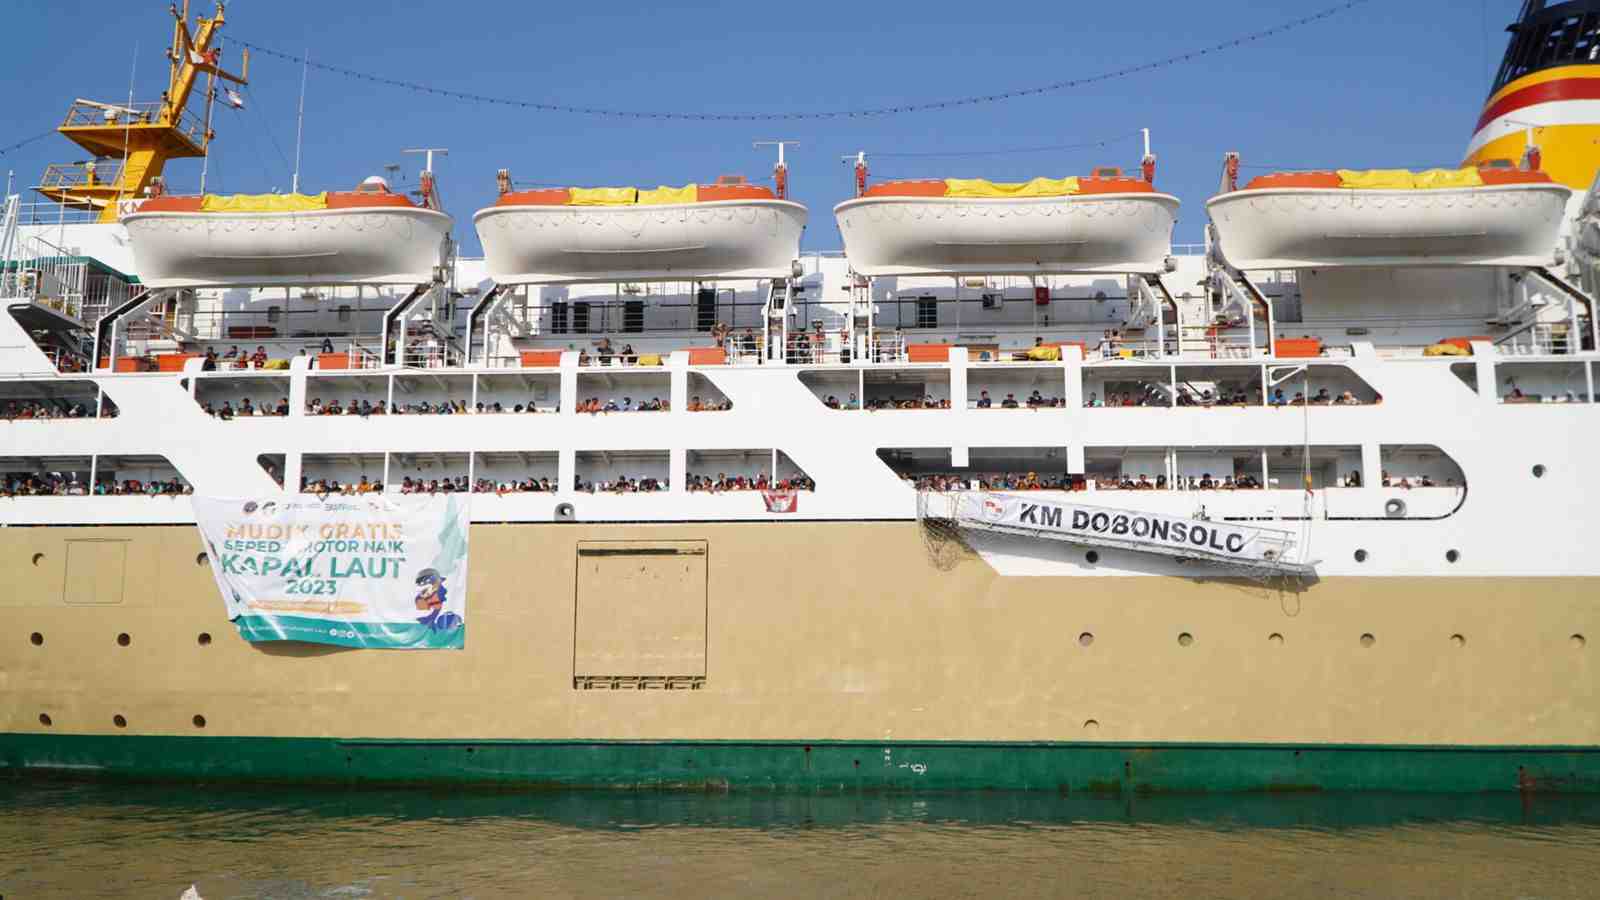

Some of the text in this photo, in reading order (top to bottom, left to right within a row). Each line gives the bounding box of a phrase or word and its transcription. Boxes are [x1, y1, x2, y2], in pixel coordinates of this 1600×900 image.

[1019, 503, 1063, 528] KM
[320, 523, 403, 539] GRATIS
[224, 540, 286, 552] SEPED
[363, 540, 404, 552] NAIK
[221, 553, 406, 578] KAPAL LAUT
[285, 579, 337, 595] 2023
